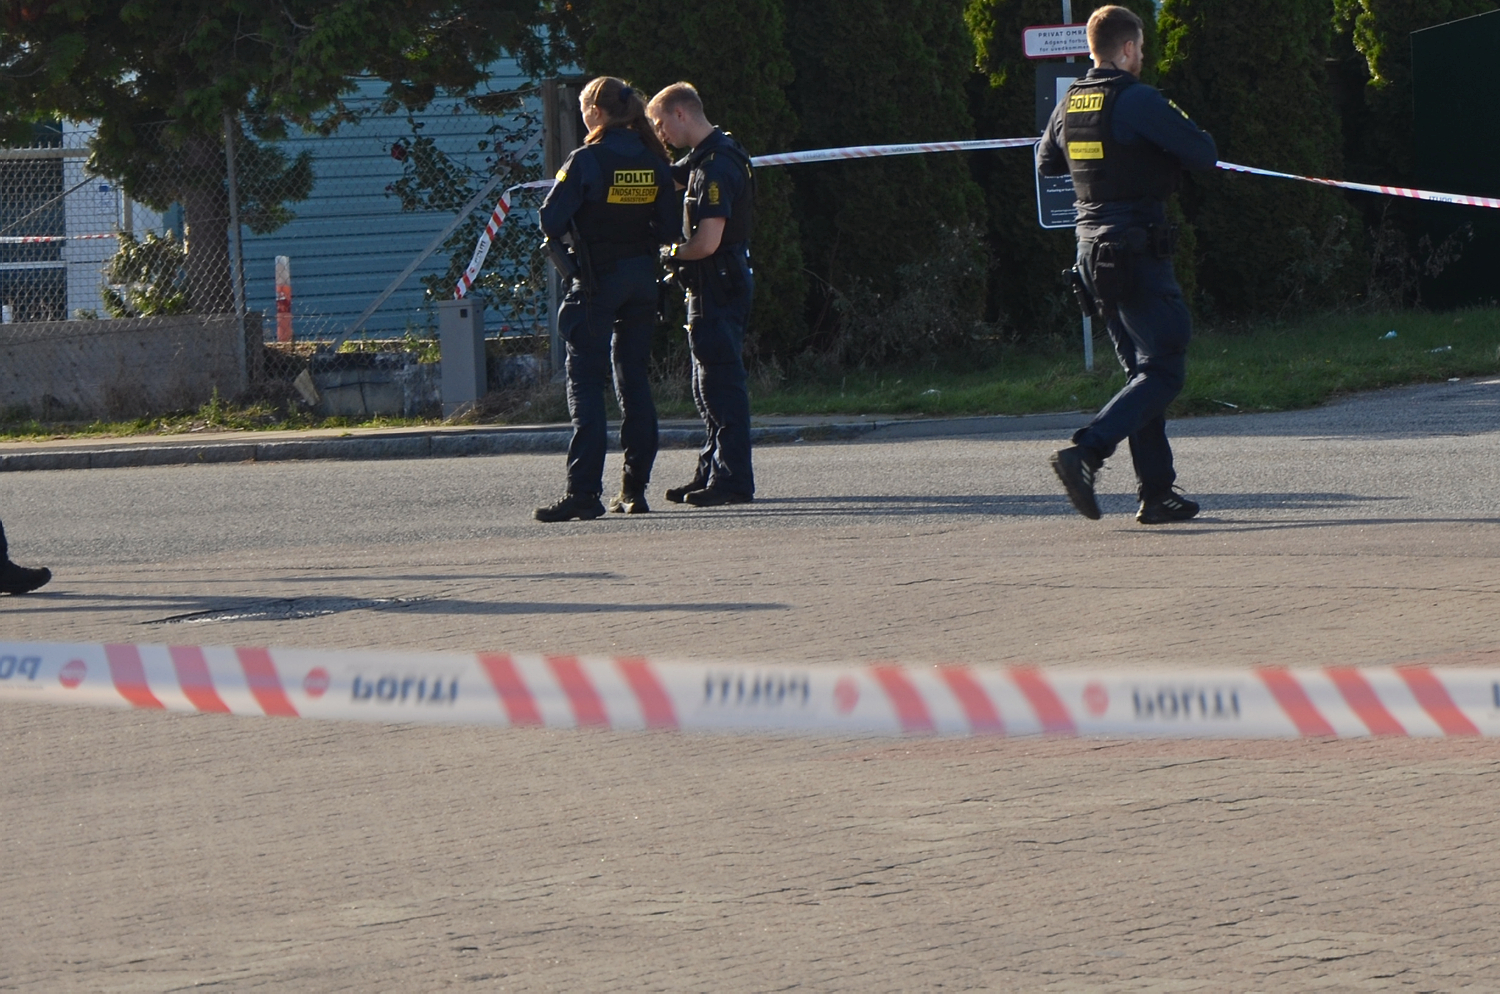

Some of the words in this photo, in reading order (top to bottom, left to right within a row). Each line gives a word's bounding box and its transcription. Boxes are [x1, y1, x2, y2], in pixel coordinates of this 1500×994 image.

[1068, 96, 1102, 109] POLITI
[615, 172, 654, 183] POLITI
[611, 187, 656, 197] INDSATSLEDER
